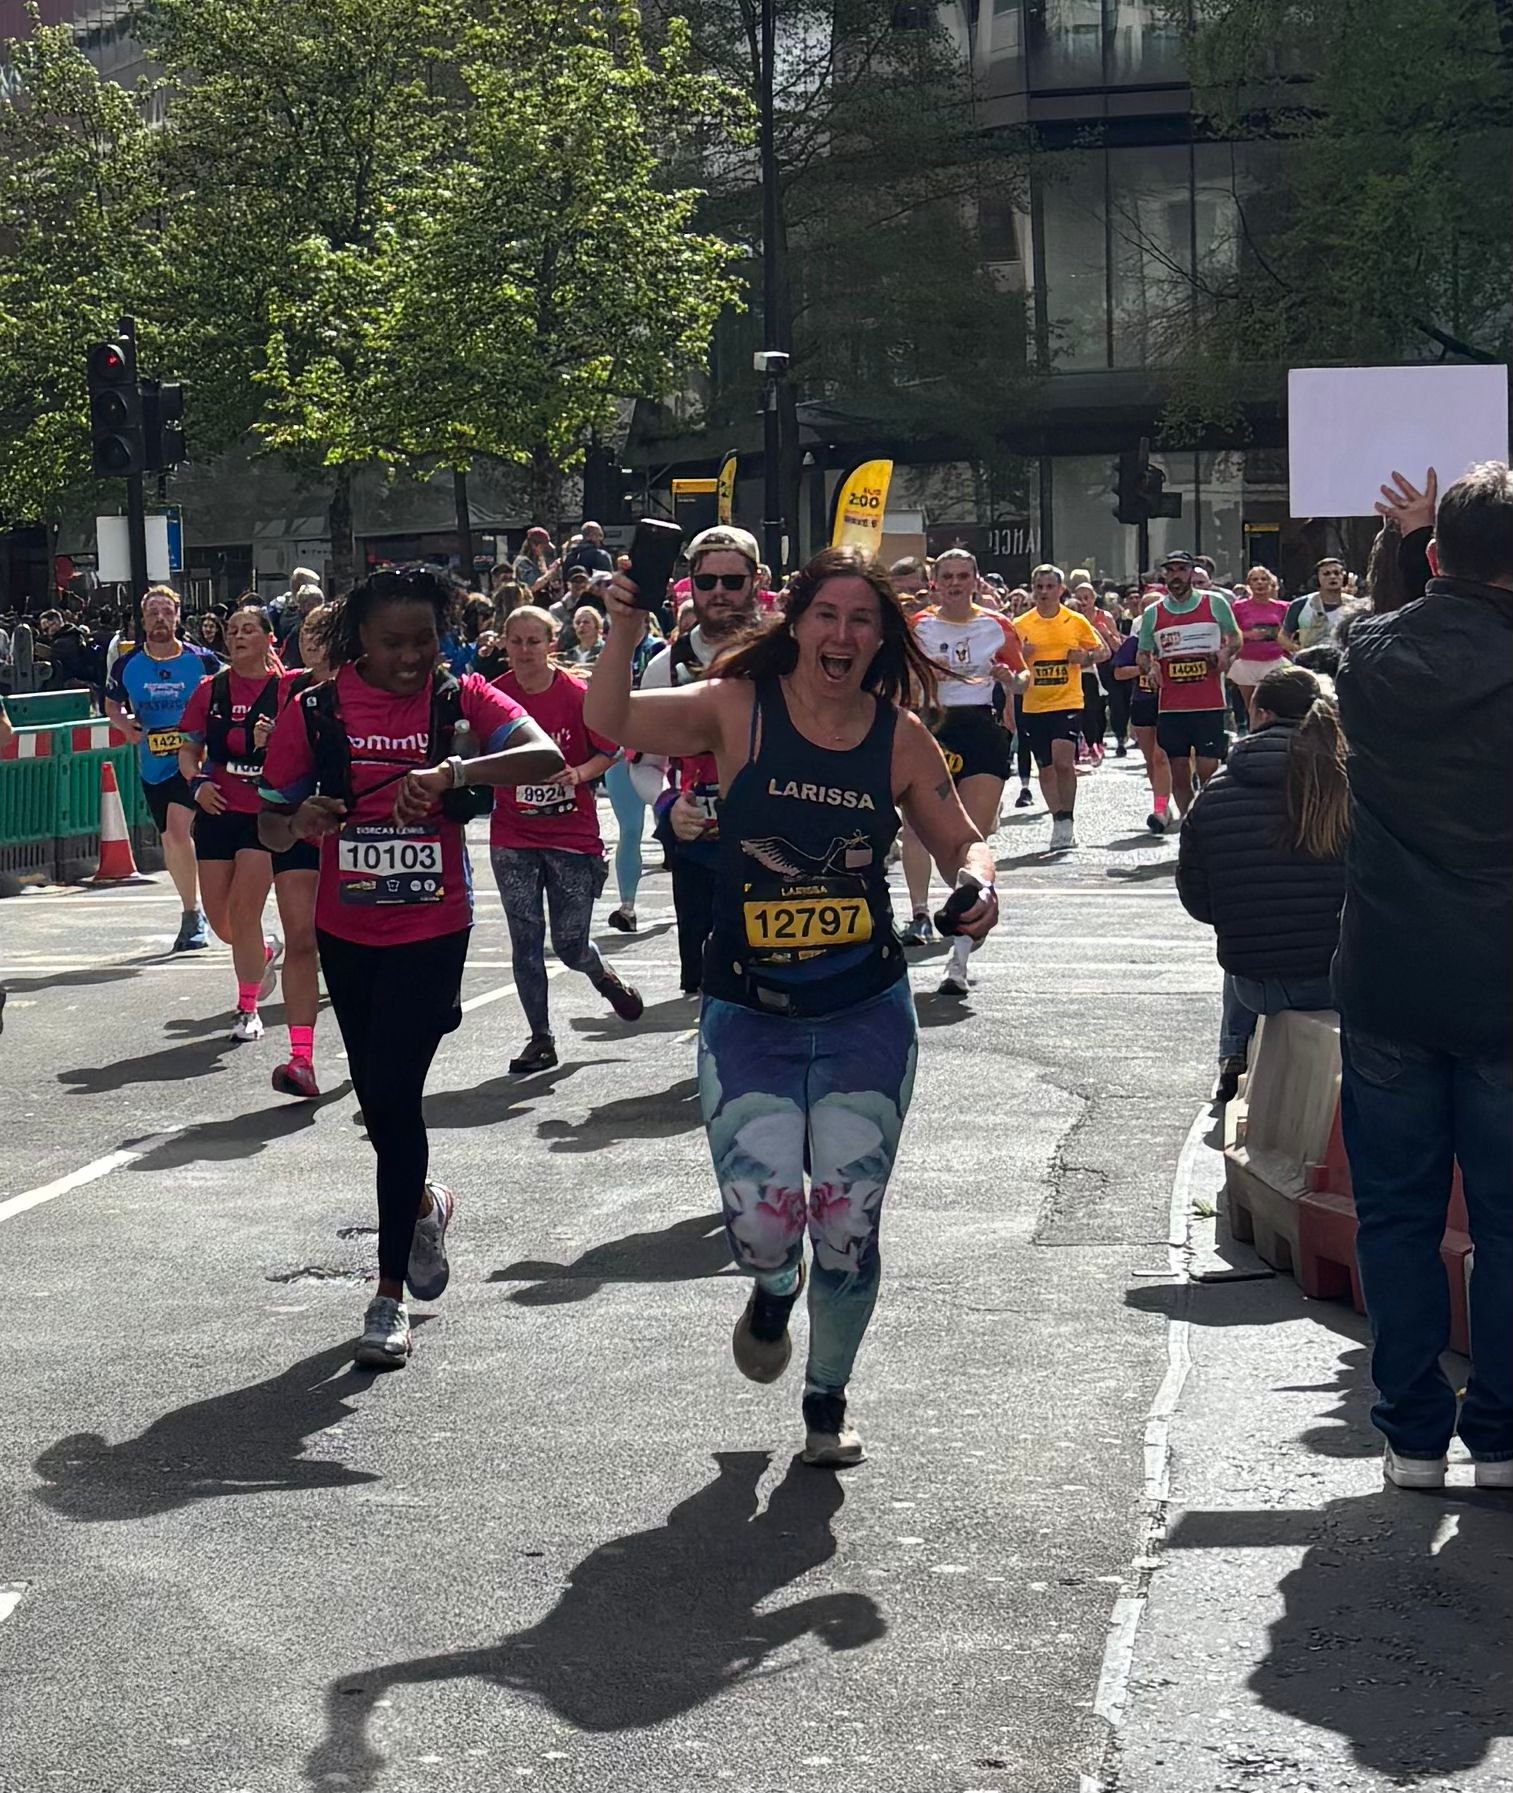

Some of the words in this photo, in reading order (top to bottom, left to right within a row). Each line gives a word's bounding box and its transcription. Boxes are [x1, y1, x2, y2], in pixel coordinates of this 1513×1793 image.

[524, 787, 566, 802] 9924
[768, 778, 875, 811] LARISSA
[346, 844, 437, 870] 10103
[754, 905, 861, 939] 12797
